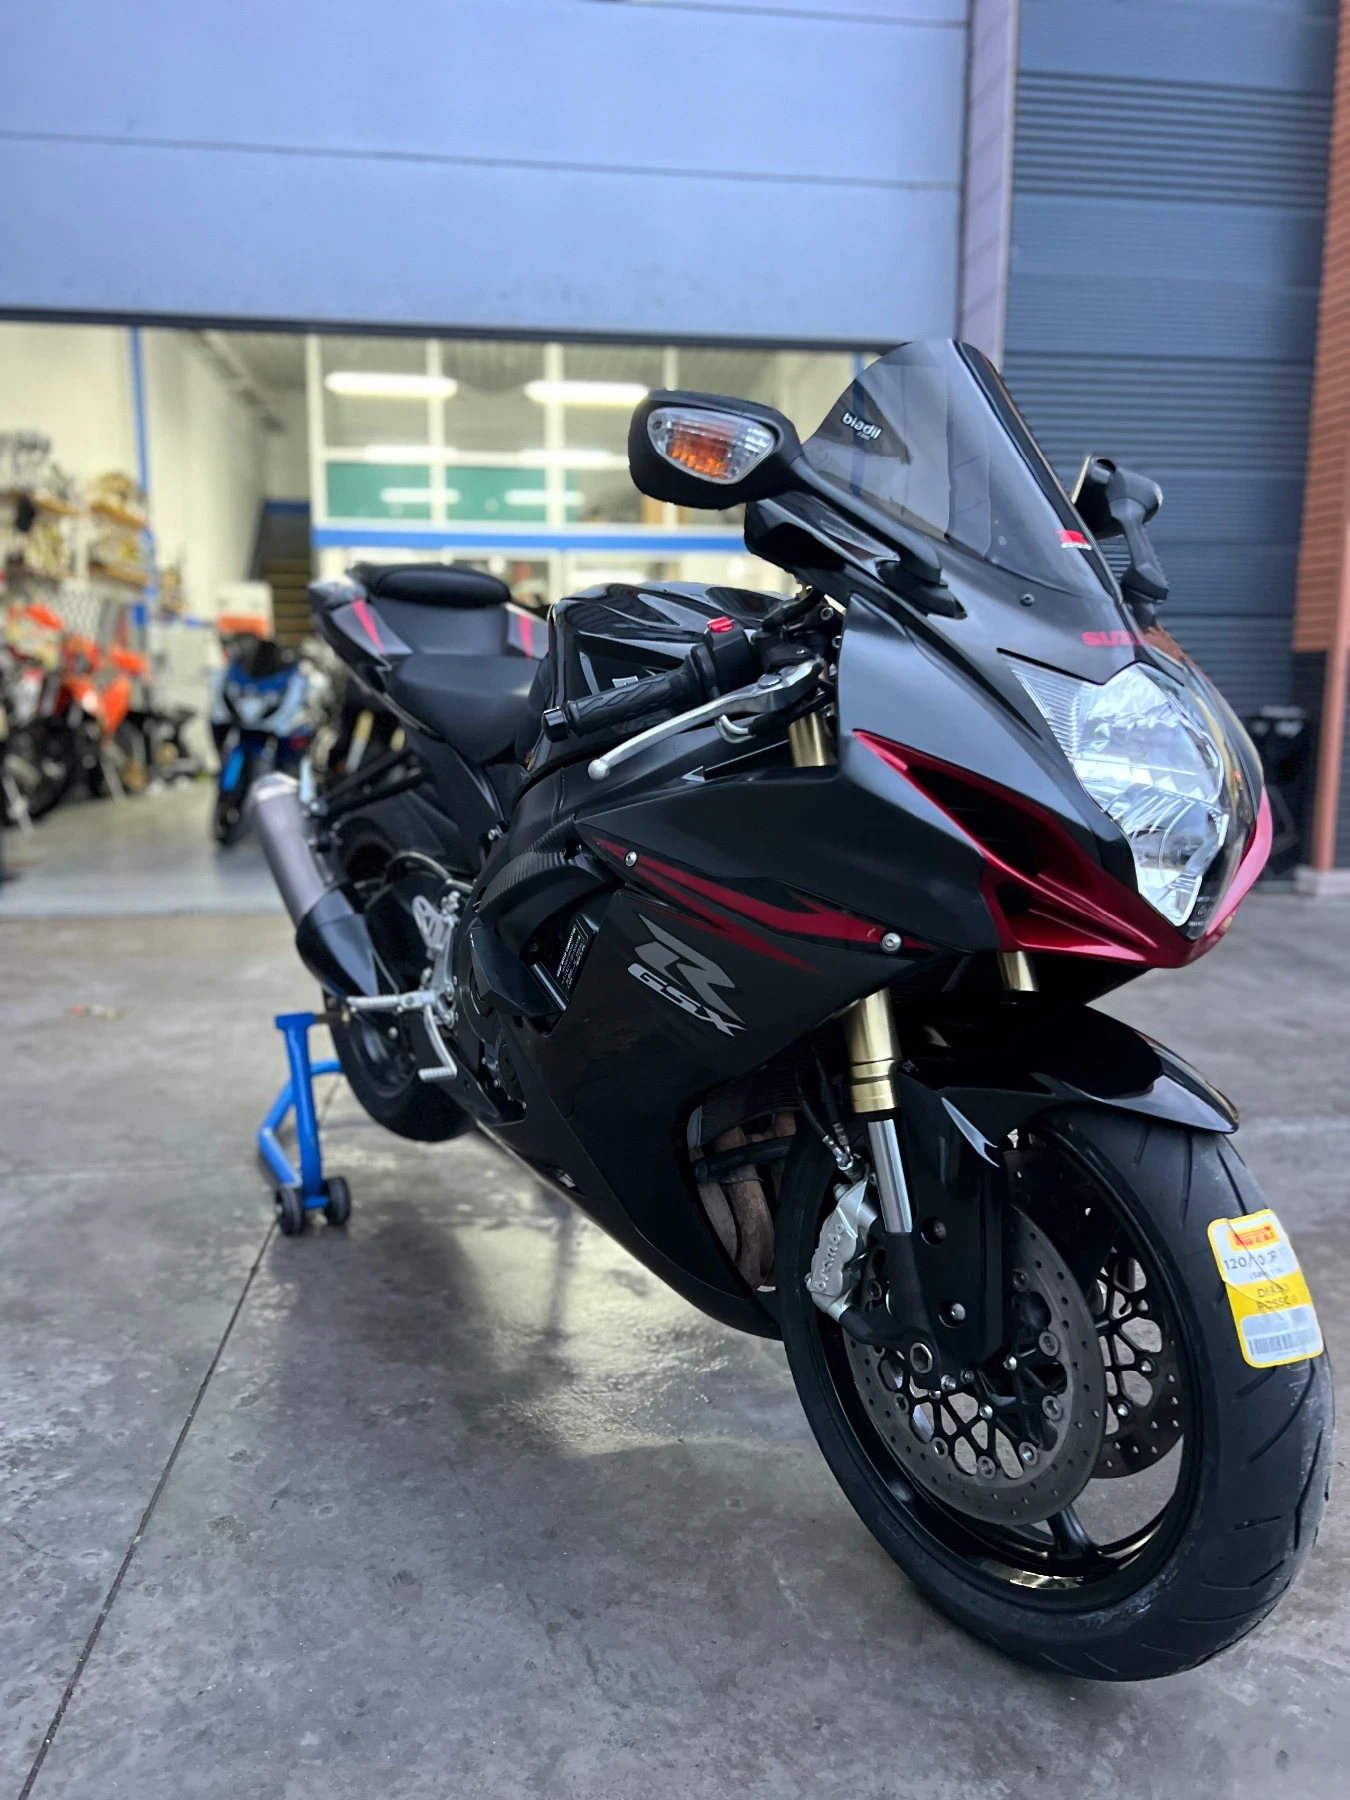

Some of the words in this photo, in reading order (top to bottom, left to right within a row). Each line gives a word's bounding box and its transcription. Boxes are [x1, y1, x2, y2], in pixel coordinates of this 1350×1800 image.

[842, 412, 882, 440] biadil
[627, 962, 748, 1037] GSX
[1223, 1254, 1266, 1271] 120/0
